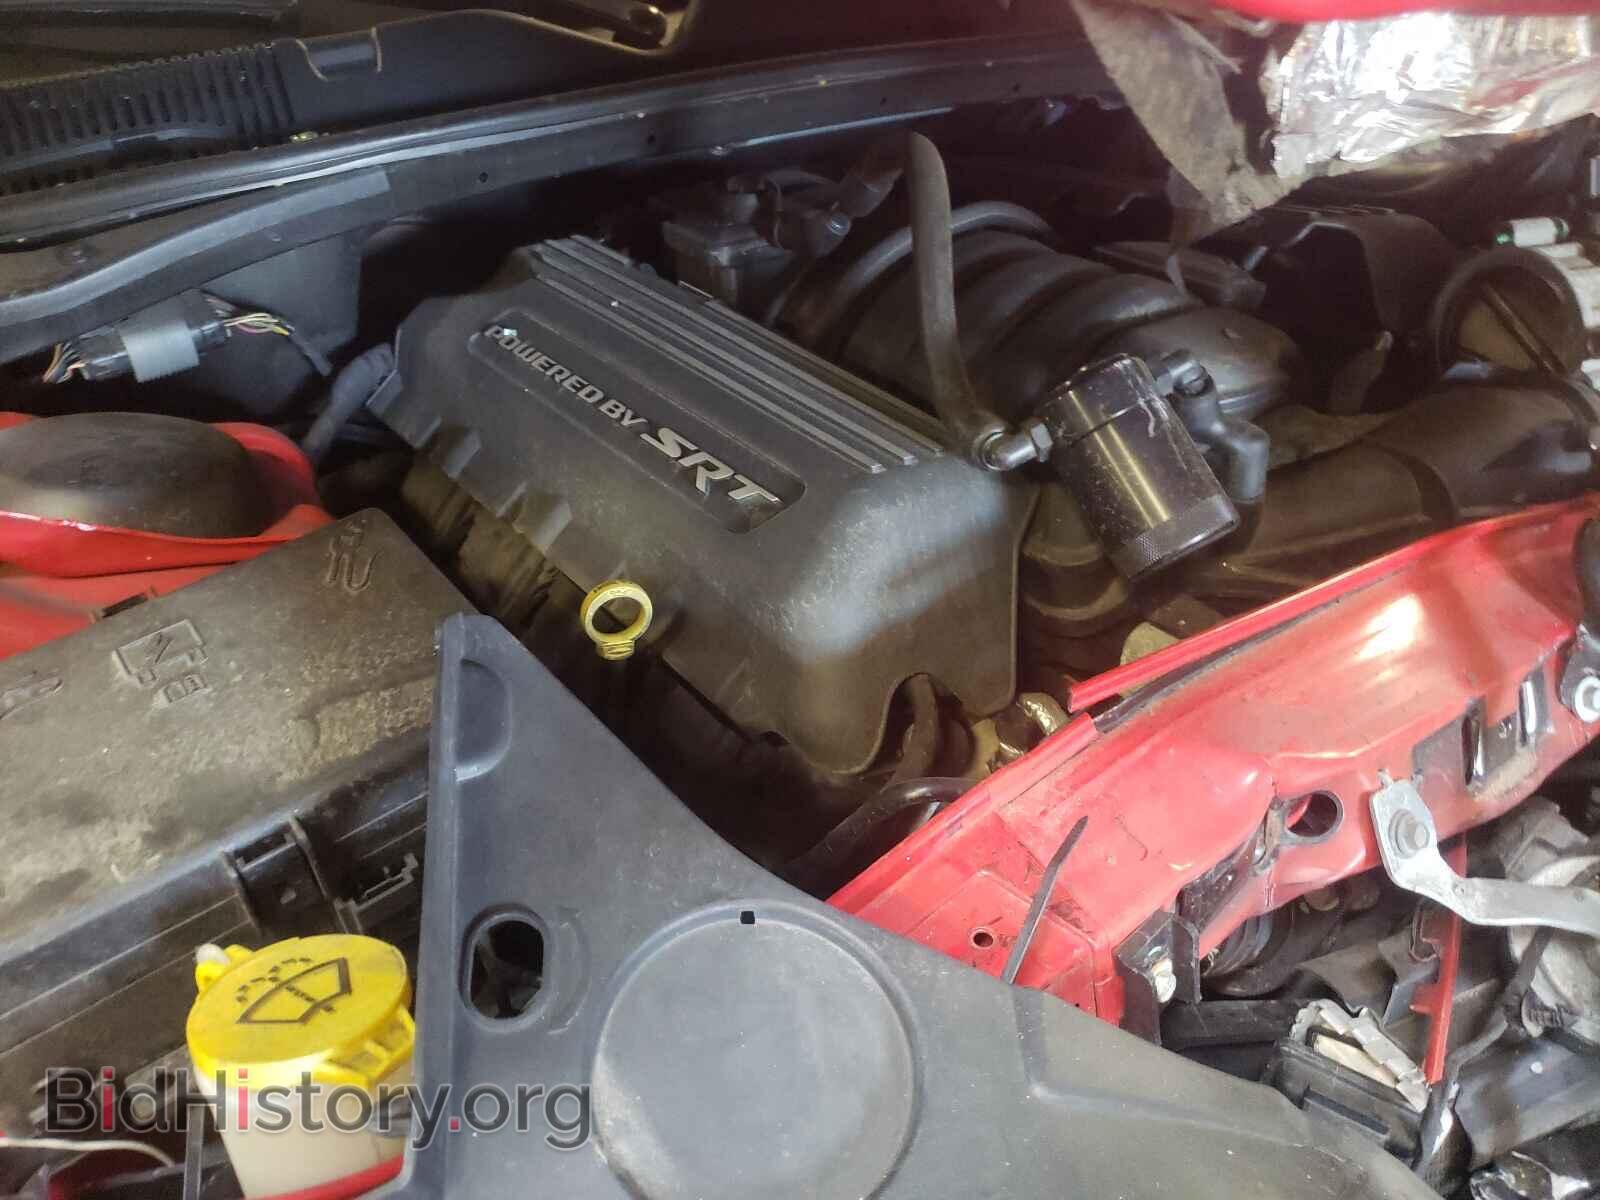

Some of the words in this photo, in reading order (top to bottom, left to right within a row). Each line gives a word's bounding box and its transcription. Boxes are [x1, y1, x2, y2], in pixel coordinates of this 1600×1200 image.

[485, 325, 605, 404] POWERED
[600, 400, 648, 427] BY
[640, 428, 781, 503] SRT
